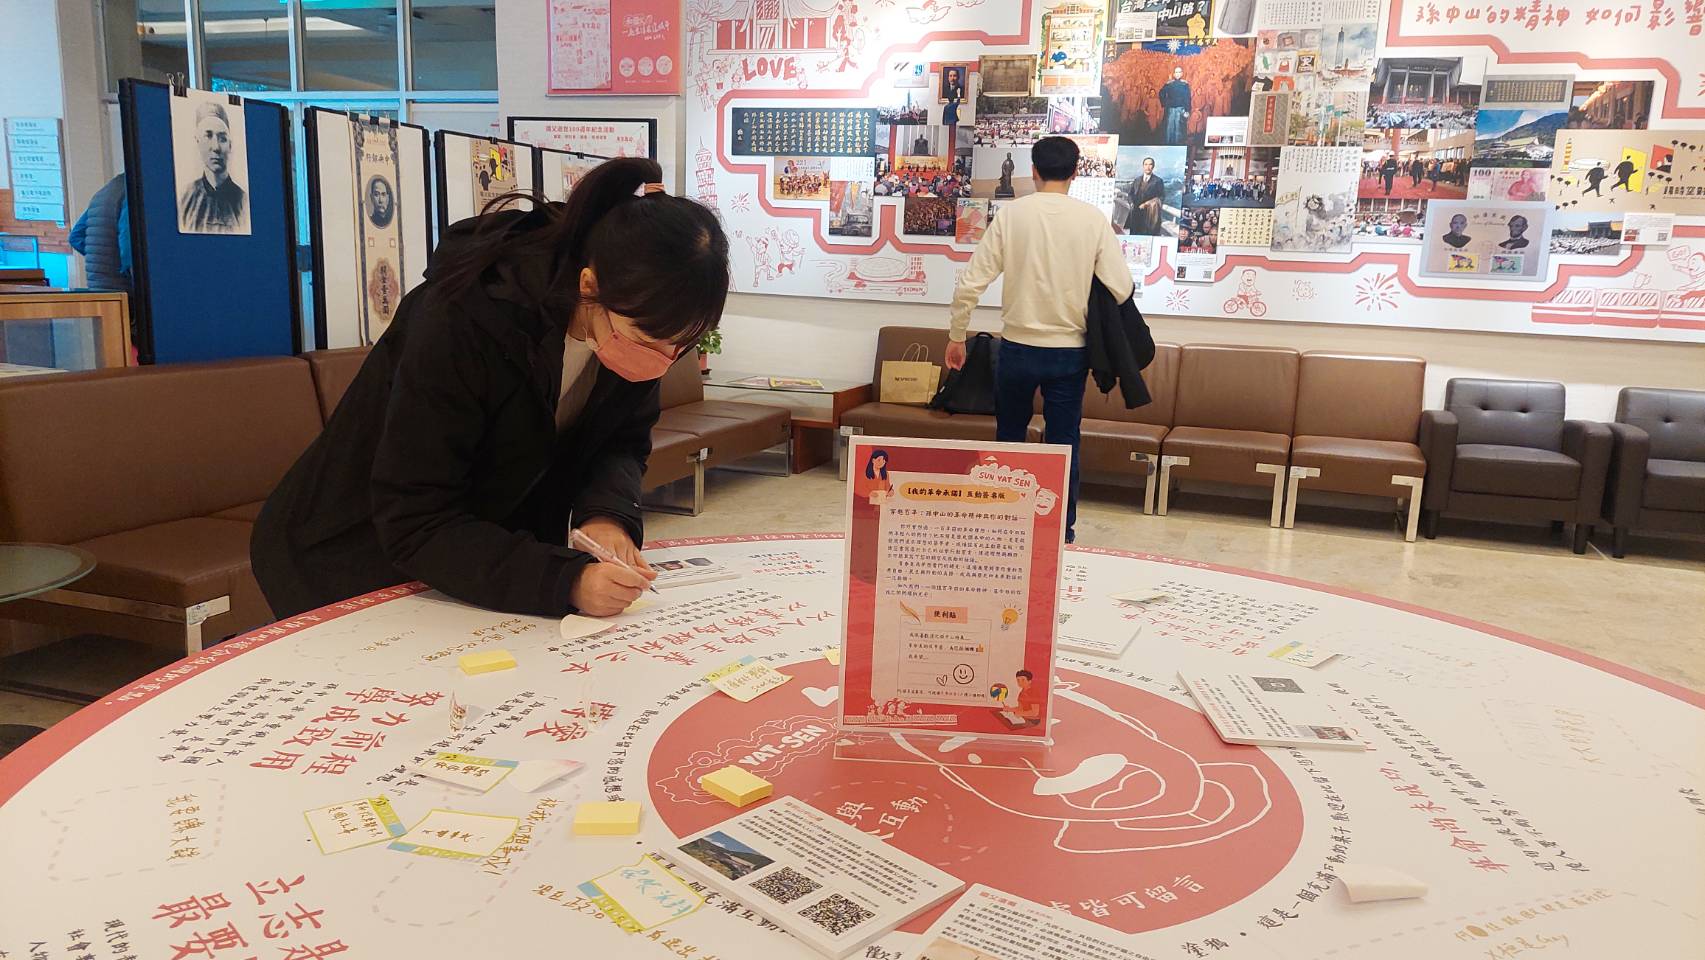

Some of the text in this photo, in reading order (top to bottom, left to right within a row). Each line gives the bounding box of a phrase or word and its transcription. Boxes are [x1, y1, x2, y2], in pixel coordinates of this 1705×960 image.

[1416, 0, 1570, 31] 孫中山的精神
[742, 57, 798, 81] LOVE
[1473, 169, 1491, 177] 100
[979, 471, 1031, 488] SUN YAT SEN
[934, 610, 957, 619] 便利貼
[562, 602, 808, 673] 以義務為權利之本
[653, 611, 836, 666] 以人道為主義
[249, 686, 397, 770] 學成致用
[301, 690, 446, 775] 努力前程
[738, 724, 830, 767] YAT-SEN
